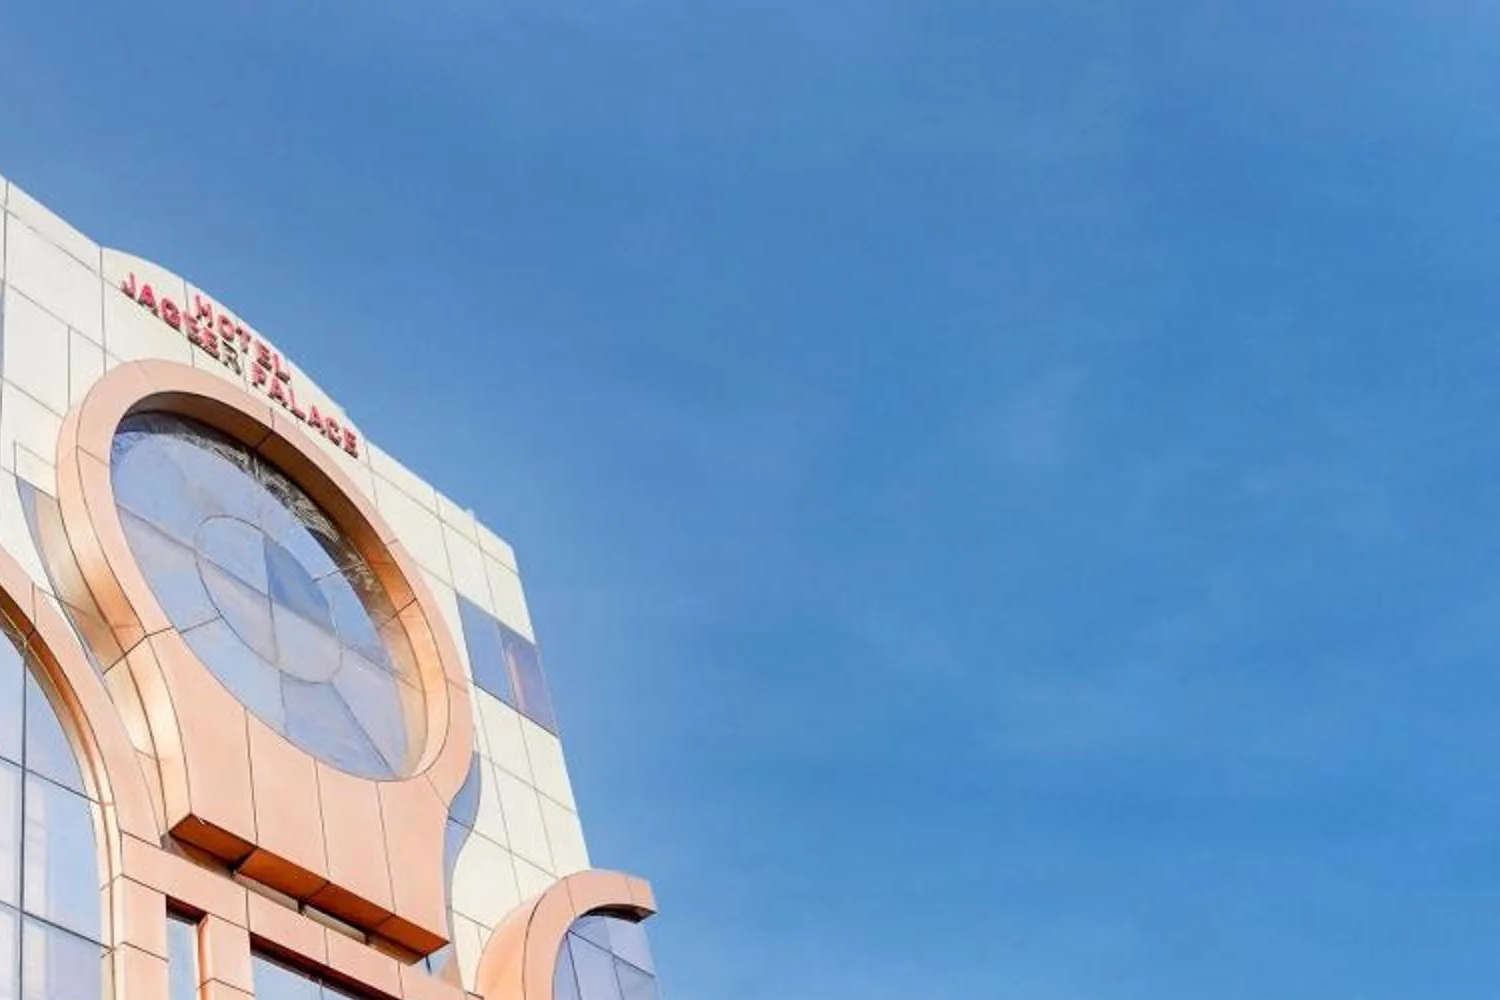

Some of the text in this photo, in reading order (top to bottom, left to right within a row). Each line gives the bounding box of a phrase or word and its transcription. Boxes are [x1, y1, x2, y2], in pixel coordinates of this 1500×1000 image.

[120, 272, 359, 460] JAGEER PALACE
[194, 294, 291, 384] HOTEL
